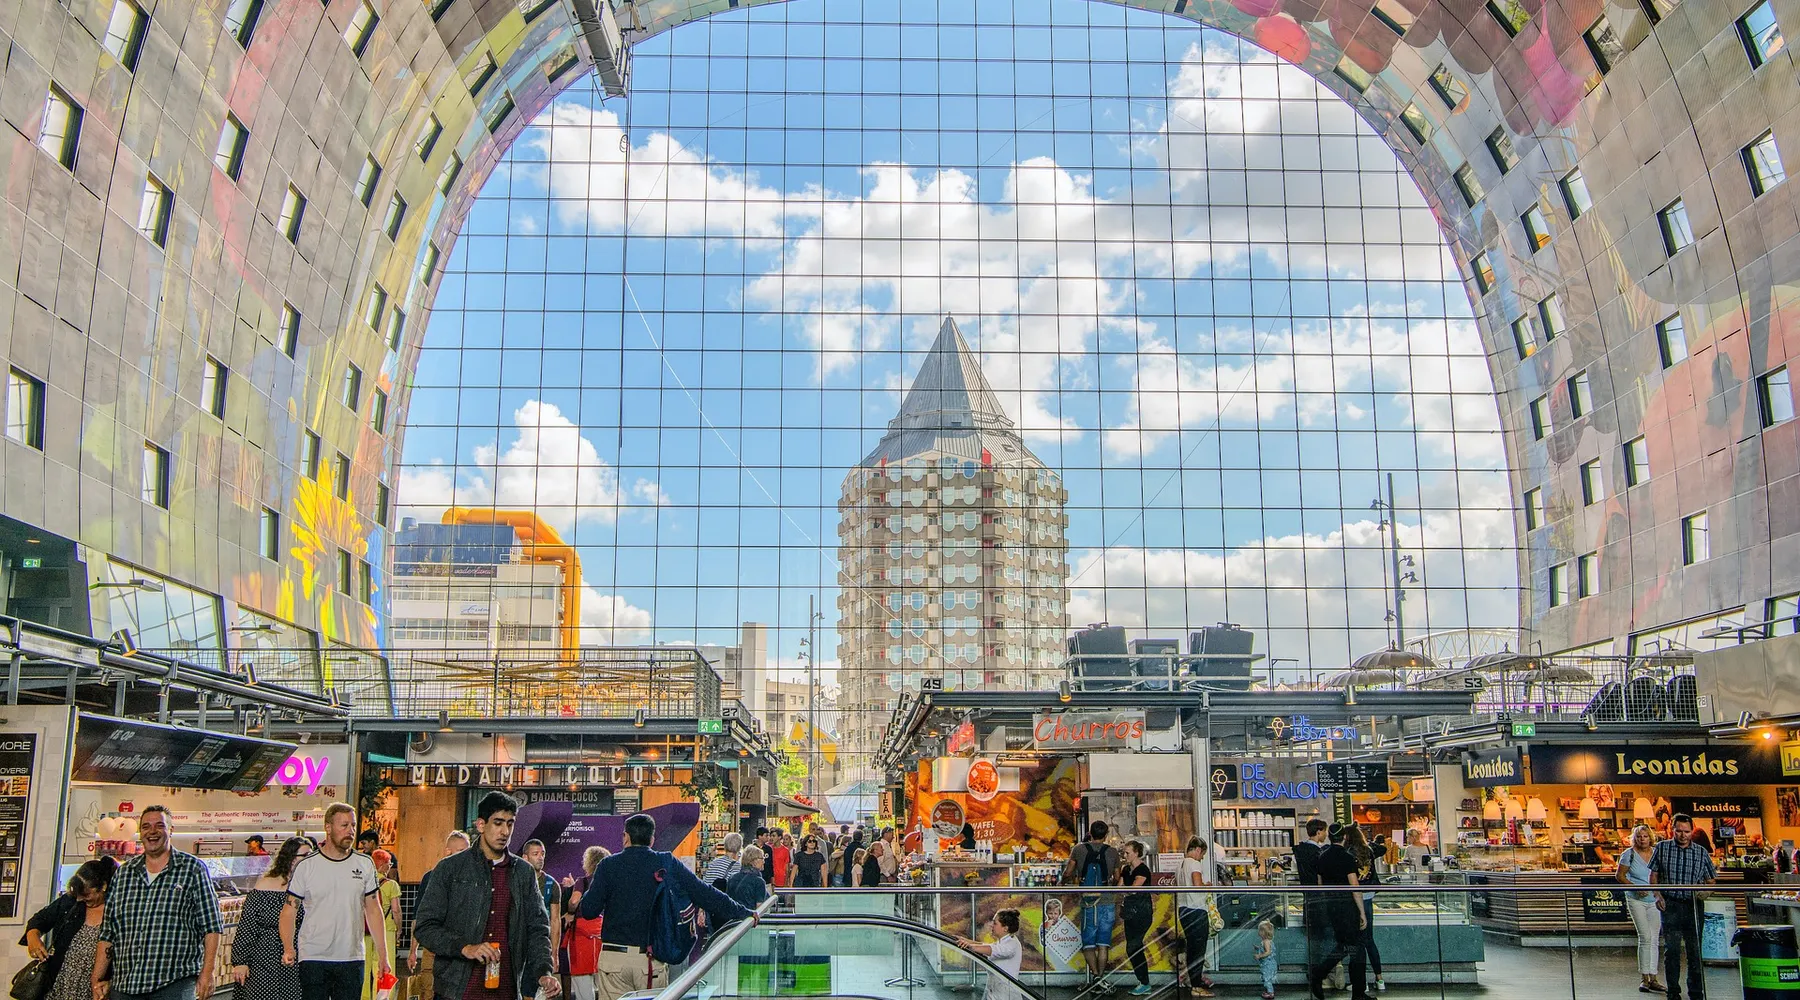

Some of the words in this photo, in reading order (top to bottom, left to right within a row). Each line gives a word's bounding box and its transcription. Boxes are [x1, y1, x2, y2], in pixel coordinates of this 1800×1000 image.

[922, 679, 941, 690] 49
[1464, 678, 1482, 688] 53
[722, 708, 738, 717] 27
[1292, 714, 1310, 727] DE
[1033, 716, 1145, 743] Churros
[1466, 756, 1515, 780] Leonidas
[1616, 752, 1740, 776] Leonidas
[411, 765, 535, 785] MADAME
[567, 765, 666, 785] COCOS
[1241, 763, 1266, 780] DE
[531, 792, 569, 802] MADAME
[571, 792, 598, 802] COCOS
[882, 792, 890, 813] TEA
[1692, 802, 1741, 812] Leonidas
[262, 811, 279, 819] Yogurt
[970, 820, 995, 830] WAFEL
[973, 829, 995, 839] 1,30
[1586, 898, 1623, 907] Leonidas
[1051, 933, 1079, 943] Churros
